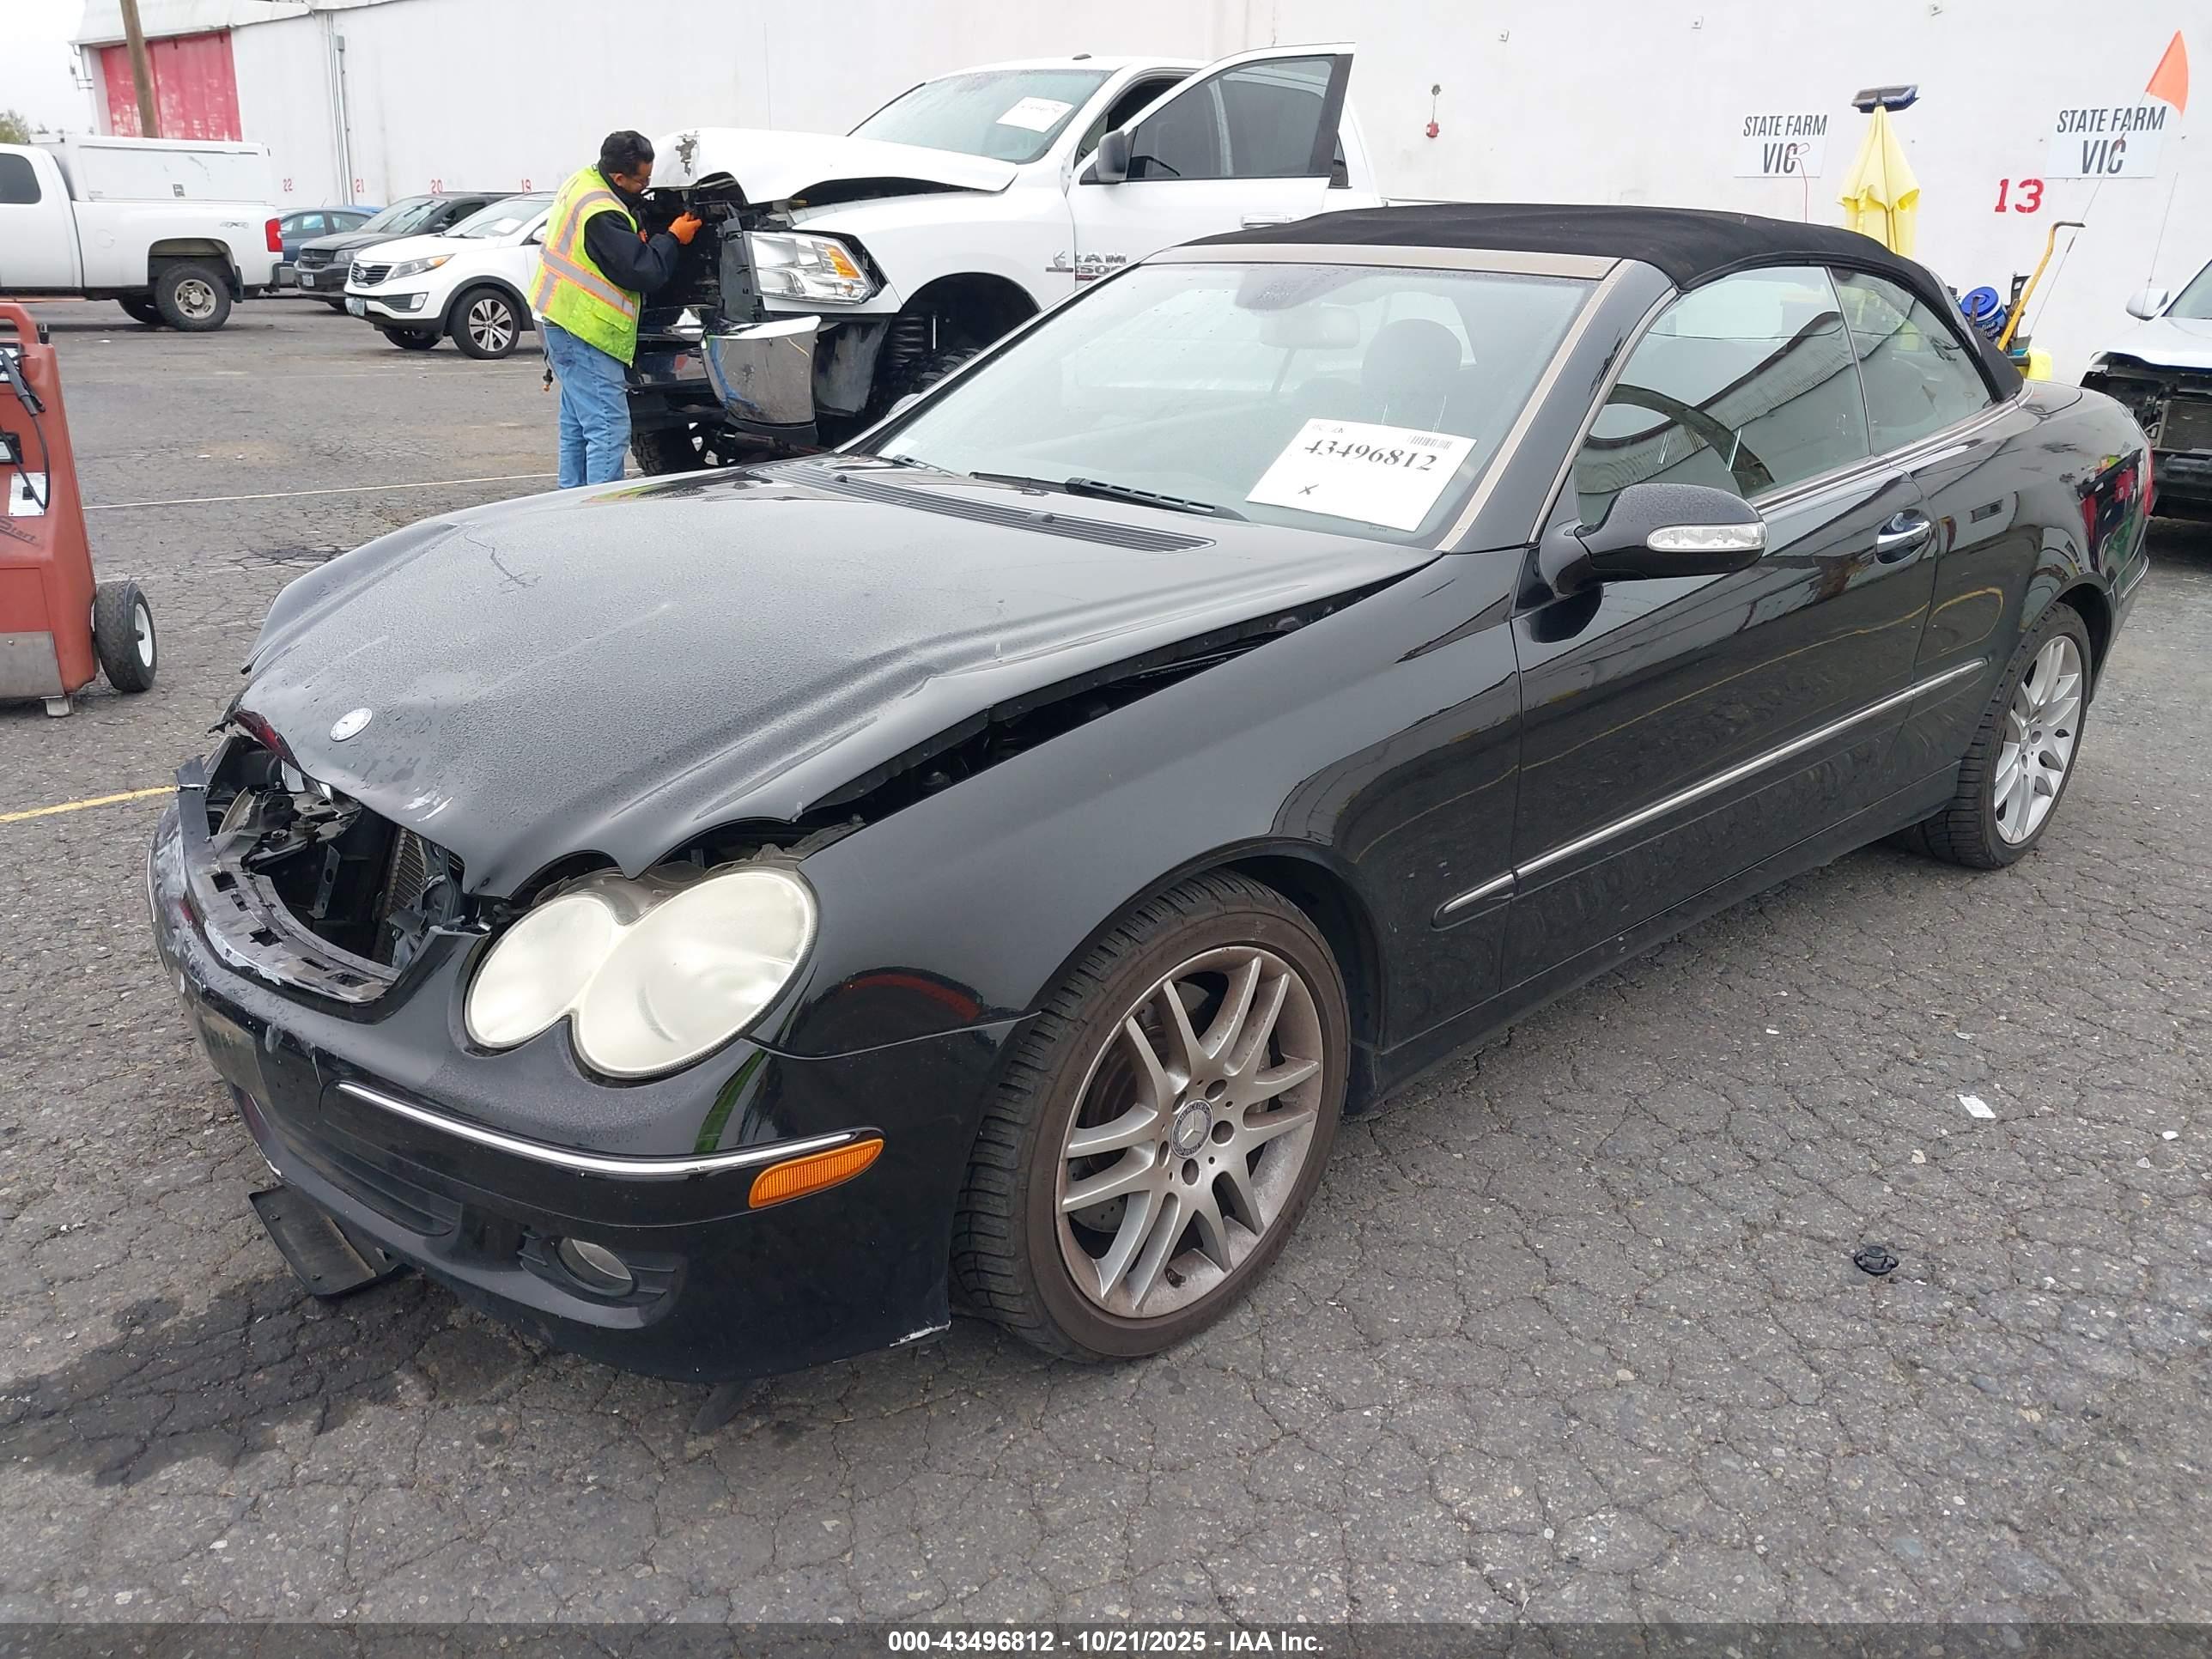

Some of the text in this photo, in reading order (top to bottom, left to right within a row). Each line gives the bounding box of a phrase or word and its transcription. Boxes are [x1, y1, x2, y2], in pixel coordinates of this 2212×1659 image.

[1743, 114, 1827, 137] STATE FARM
[2057, 106, 2166, 133] STATE FARM
[1763, 143, 1798, 173] VIC
[2081, 138, 2126, 174] VIC
[283, 178, 293, 192] 22
[355, 178, 365, 193] 21
[431, 179, 443, 194] 20
[1994, 179, 2045, 213] 13
[1304, 439, 1437, 471] 43496812
